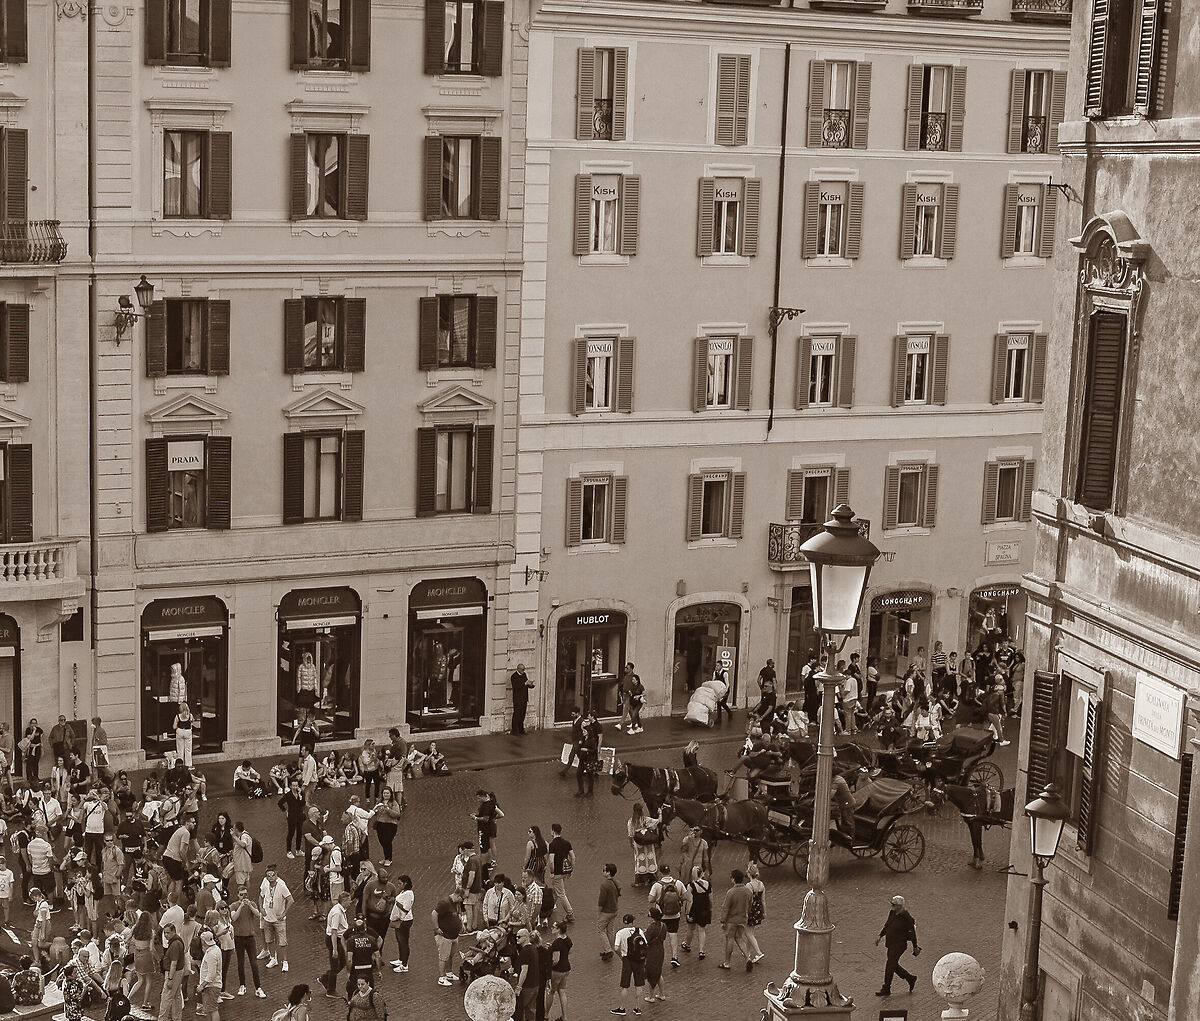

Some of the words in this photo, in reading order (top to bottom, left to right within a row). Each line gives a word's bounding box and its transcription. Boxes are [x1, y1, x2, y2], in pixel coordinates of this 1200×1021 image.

[171, 456, 199, 464] PRADA
[427, 586, 467, 597] MONCLER
[980, 589, 1020, 598] LONGCHAMP
[297, 595, 341, 607] MONCLER
[881, 596, 923, 606] LONGCHAMP
[161, 605, 206, 617] MONCLER
[576, 615, 610, 625] HUBLOT
